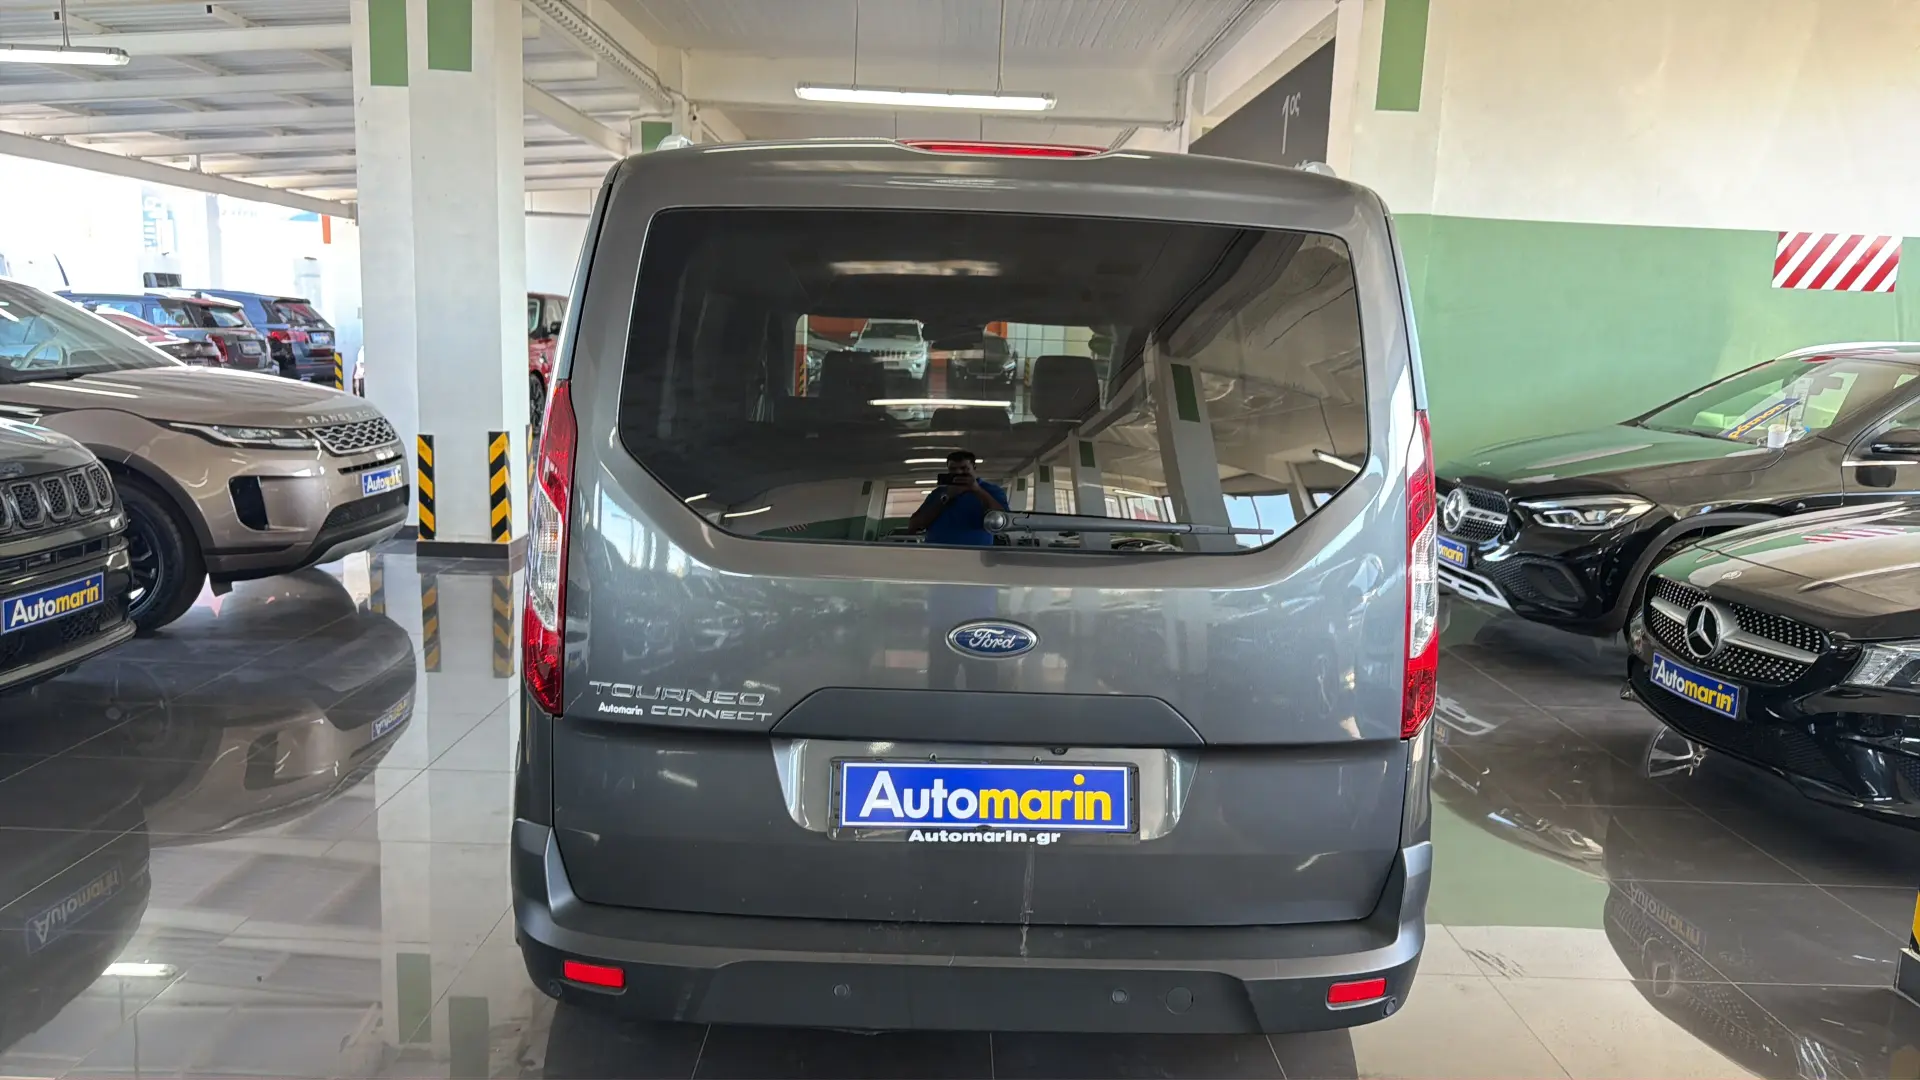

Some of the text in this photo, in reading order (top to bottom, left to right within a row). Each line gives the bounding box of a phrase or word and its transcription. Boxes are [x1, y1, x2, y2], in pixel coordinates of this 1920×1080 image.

[10, 579, 100, 627] Automarin
[965, 628, 1016, 648] Ford
[589, 680, 765, 707] TOURNEO
[1655, 659, 1733, 712] Automarin
[598, 701, 643, 716] Automarin
[651, 705, 772, 722] CONNECT
[859, 770, 1112, 821] Automarin
[908, 829, 1061, 846] Automarin.gr
